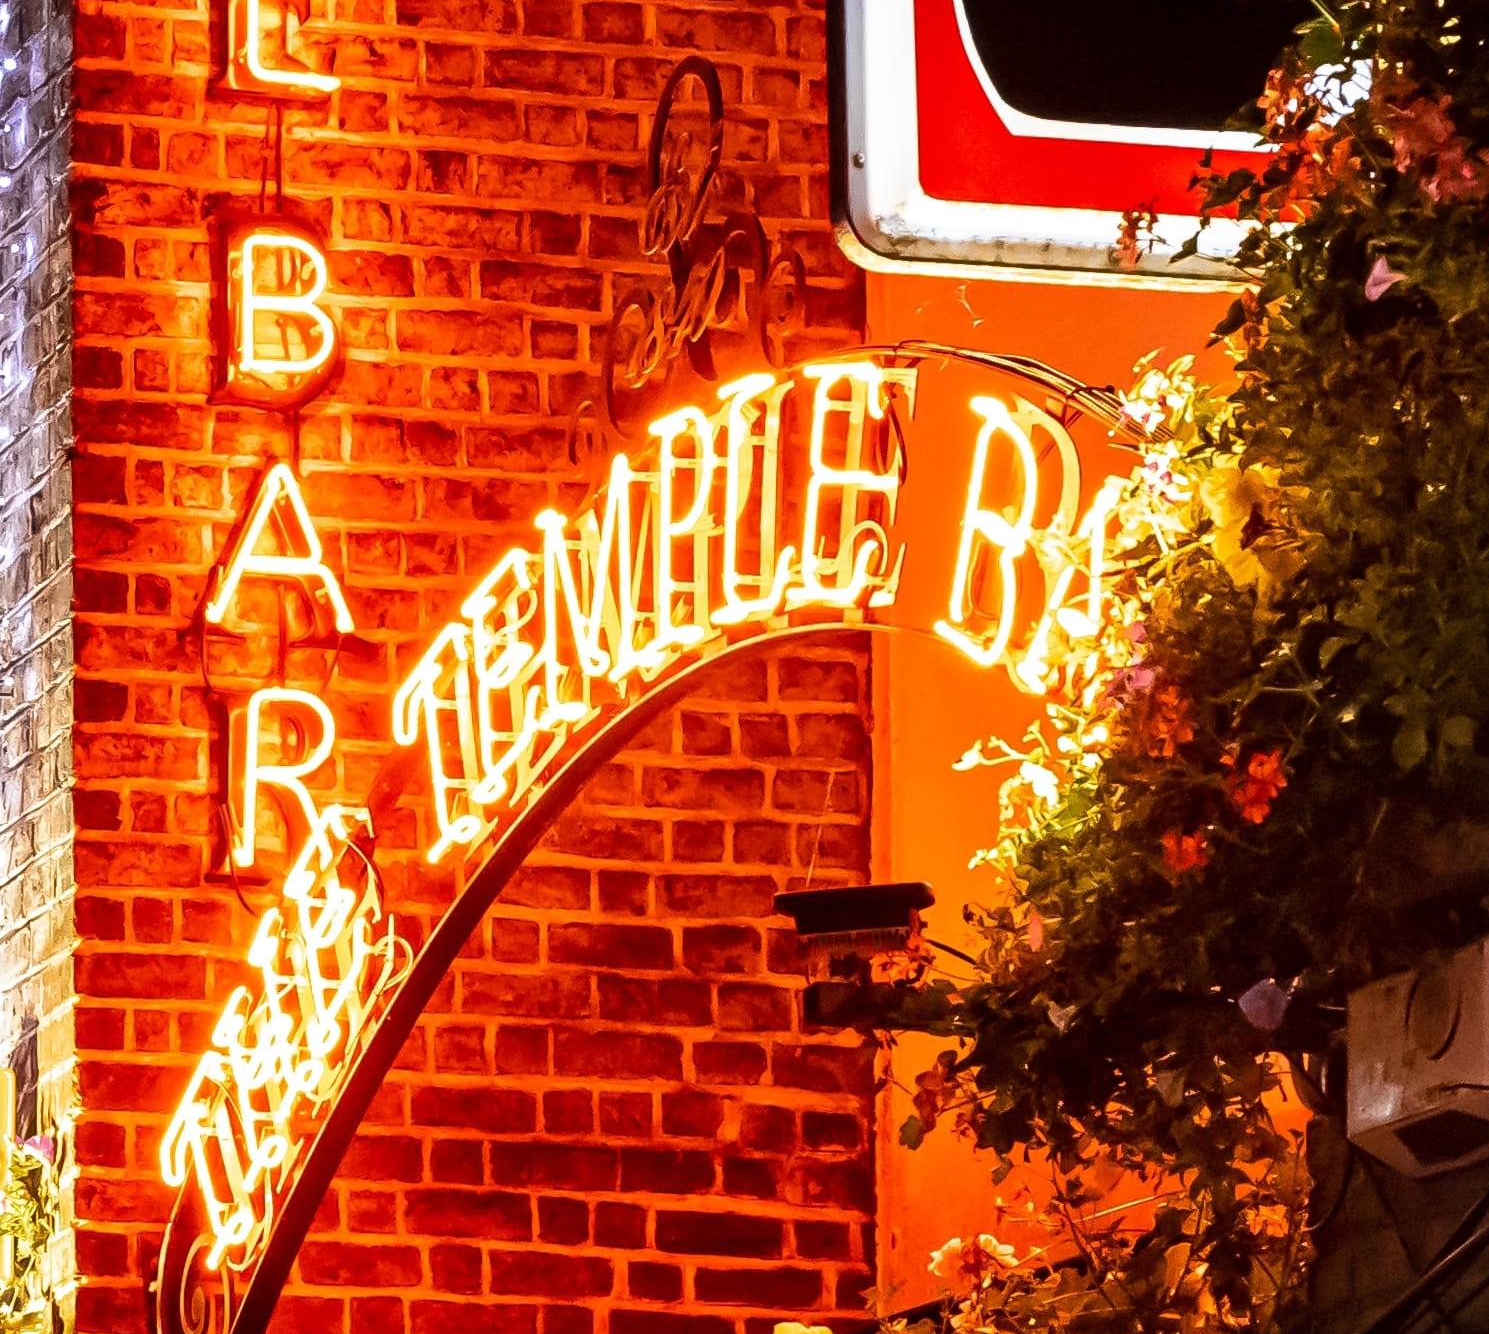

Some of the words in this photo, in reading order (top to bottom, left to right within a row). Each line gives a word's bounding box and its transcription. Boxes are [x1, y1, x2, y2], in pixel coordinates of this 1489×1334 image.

[206, 233, 355, 872] BAR
[392, 361, 910, 865] TEMPLE
[932, 395, 1124, 697] BA
